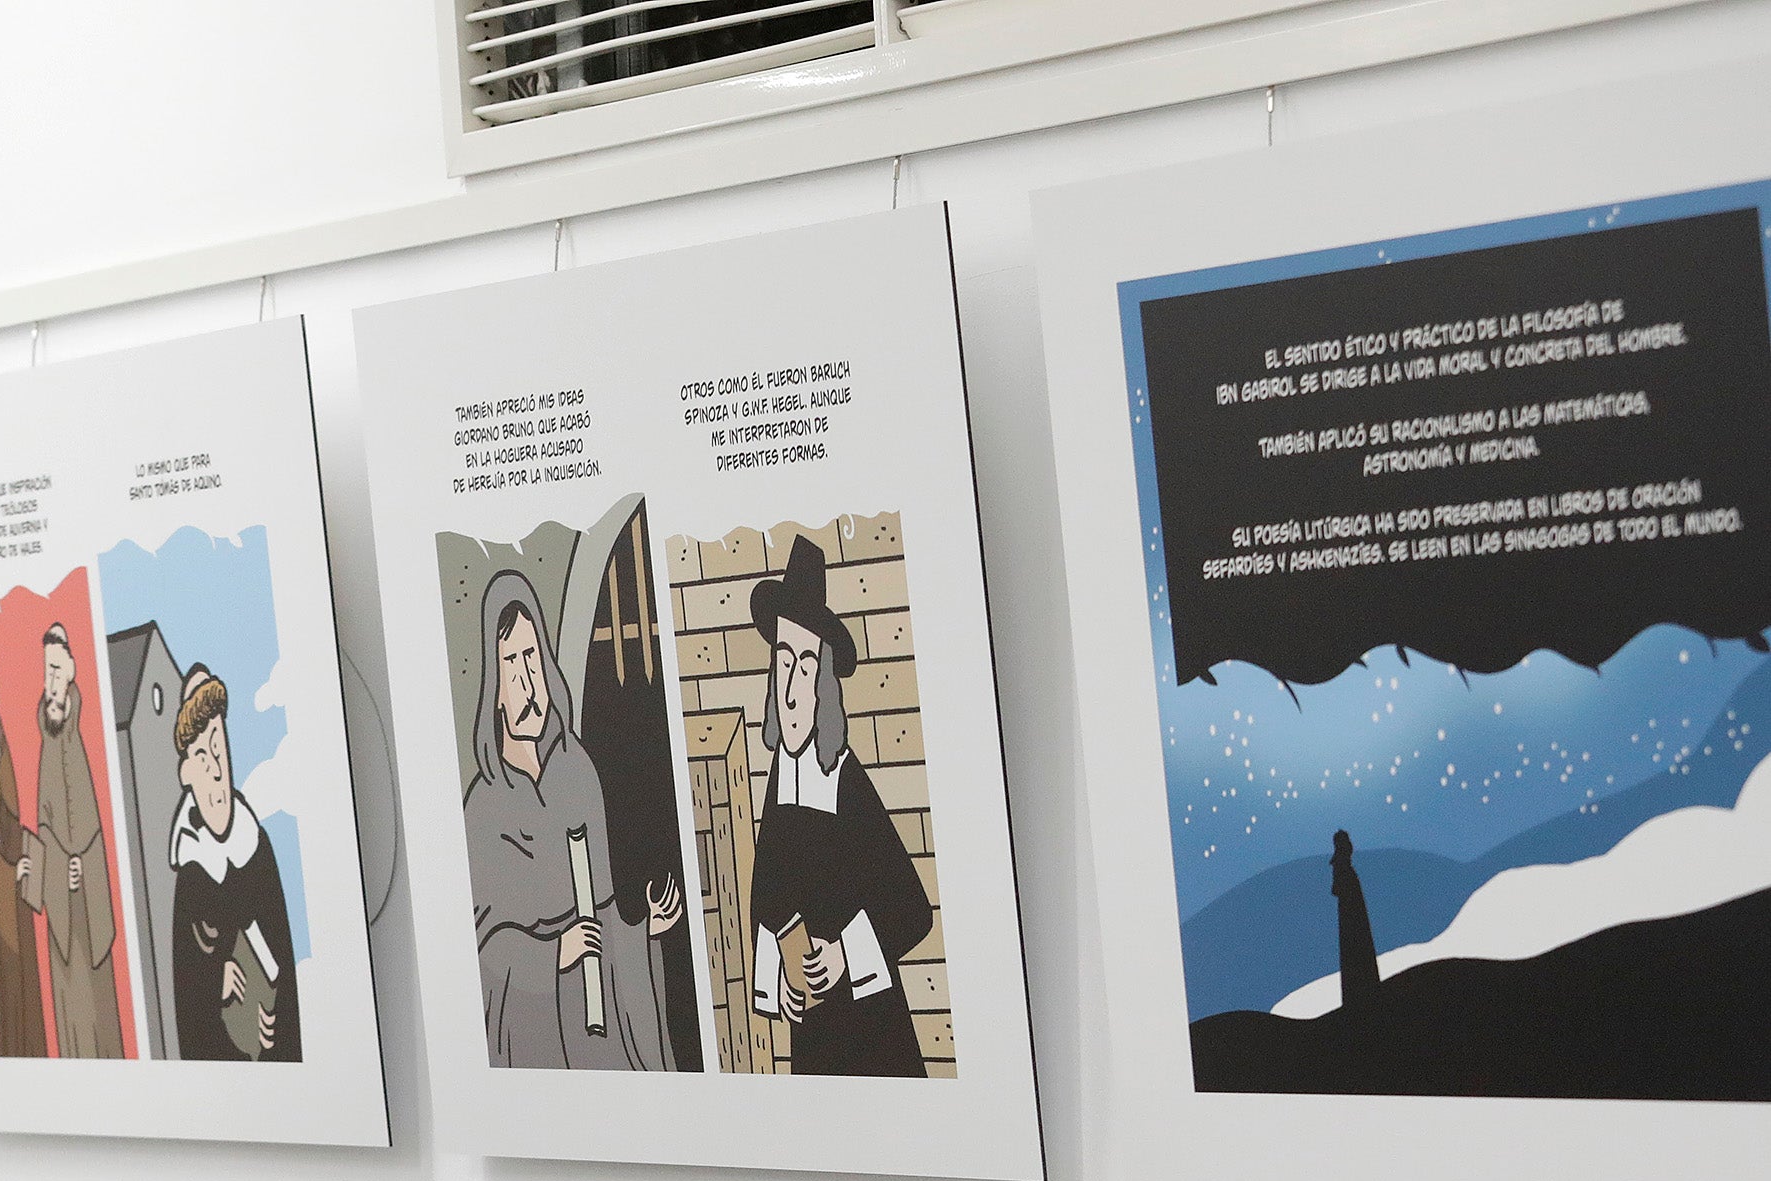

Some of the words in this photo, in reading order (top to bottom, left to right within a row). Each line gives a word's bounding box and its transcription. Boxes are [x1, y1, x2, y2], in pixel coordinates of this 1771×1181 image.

[1264, 348, 1281, 369] EL
[1283, 339, 1341, 367] SENTIDO
[1344, 332, 1386, 358] ÉTICO
[1388, 331, 1398, 350] Y
[1401, 320, 1474, 348] PRÁCTICO
[1476, 317, 1497, 340] DE
[1500, 314, 1519, 337] LA
[1521, 302, 1598, 333] FILOSOFÍA
[1600, 300, 1624, 323] DE
[680, 380, 714, 401] OTROS
[717, 375, 748, 395] COMO
[751, 371, 763, 390] ÉL
[766, 366, 807, 388] FUERON
[809, 360, 850, 382] BARUCH
[1215, 383, 1238, 405] IBN
[1240, 375, 1297, 402] GABIROL
[1299, 372, 1319, 394] SE
[1320, 365, 1367, 391] DIRIGE
[1369, 364, 1380, 385] A
[1383, 361, 1401, 383] LA
[1403, 357, 1435, 379] VIDA
[1438, 351, 1487, 375] MORAL
[1490, 348, 1499, 366] Y
[1504, 337, 1582, 368] CONCRETA
[1584, 334, 1614, 356] DEL
[455, 400, 493, 421] TAMBIÉN
[496, 393, 535, 417] APRECIÓ
[538, 392, 555, 409] MIS
[557, 388, 584, 406] IDEAS
[684, 403, 729, 425] SPINOZA
[731, 401, 738, 418] Y
[741, 397, 768, 417] G.W.F.
[771, 393, 807, 413] HEGEL.
[810, 386, 851, 408] AUNQUE
[454, 425, 499, 446] GIORDANO
[501, 420, 534, 440] BRUNO,
[537, 416, 557, 434] QUE
[559, 409, 590, 432] ACABÓ
[711, 429, 725, 446] ME
[728, 417, 811, 444] INTERPRETARON
[813, 415, 828, 433] DE
[1257, 430, 1315, 457] TAMBIÉN
[1317, 423, 1366, 451] APLICÓ
[1369, 423, 1389, 445] SU
[1391, 410, 1494, 441] RACIONALISMO
[1497, 408, 1509, 429] A
[1512, 404, 1541, 428] LAS
[465, 452, 478, 468] EN
[480, 450, 491, 466] LA
[493, 444, 538, 464] HOGUERA
[540, 437, 583, 459] ACUSADO
[716, 448, 779, 471] DIFERENTES
[781, 442, 828, 464] FORMAS.
[1362, 444, 1452, 475] ASTRONOMÍA
[1455, 444, 1464, 462] Y
[452, 477, 465, 493] DE
[467, 470, 506, 491] HEREJÍA
[507, 469, 527, 486] POR
[529, 468, 541, 484] LA
[544, 458, 601, 482] INQUISICIÓN.
[1231, 526, 1251, 548] SU
[1252, 519, 1301, 545] POESÍA
[1304, 514, 1371, 541] LITÚRGICA
[1373, 512, 1394, 533] HA
[1396, 508, 1430, 532] SIDO
[1432, 499, 1524, 526] PRESERVADA
[1526, 497, 1548, 518] EN
[1551, 490, 1603, 516] LIBROS
[1606, 488, 1627, 510] DE
[1632, 481, 1700, 509] ORACIÓN
[1202, 551, 1274, 580] SEFARDÍES
[1276, 552, 1286, 571] Y
[1387, 540, 1408, 562] SE
[1411, 537, 1447, 560] LEEN
[1449, 535, 1470, 556] EN
[1472, 531, 1501, 554] LAS
[1503, 523, 1590, 552] SINAGOGAS
[1592, 520, 1613, 542] DE
[1618, 516, 1657, 541] TODO
[1661, 515, 1680, 536] EL
